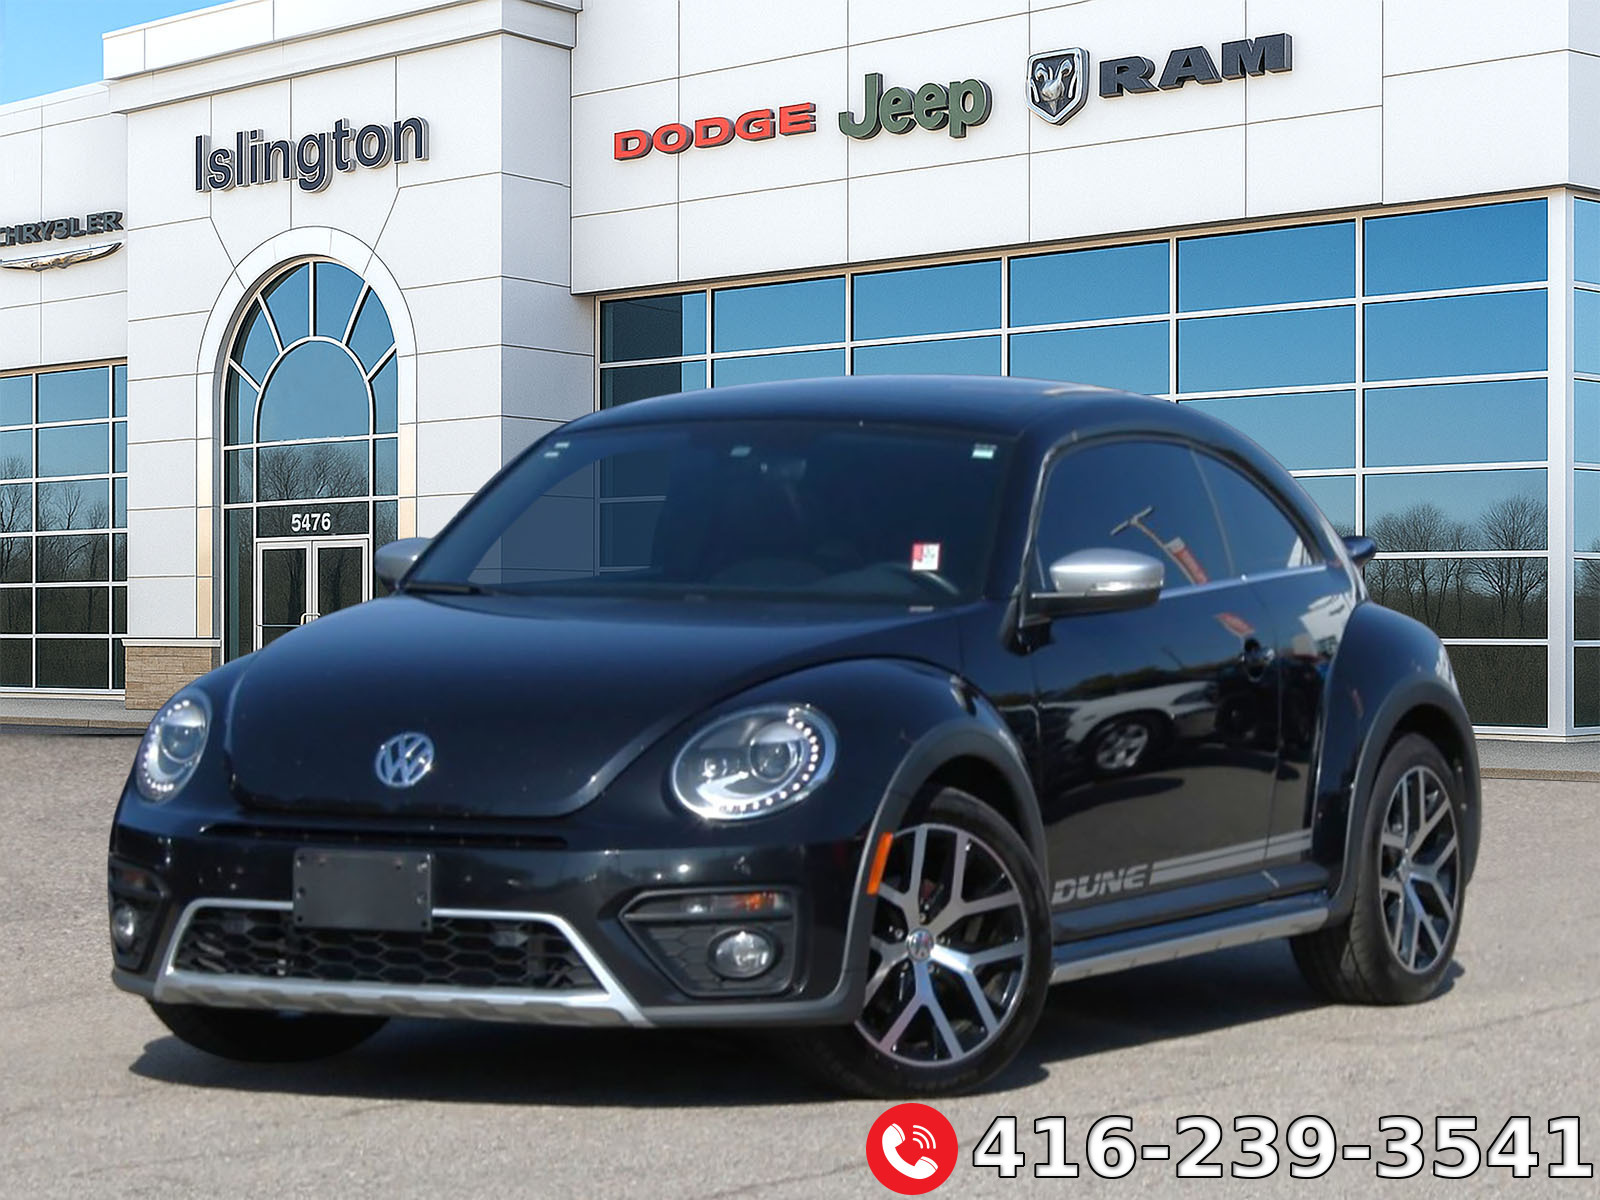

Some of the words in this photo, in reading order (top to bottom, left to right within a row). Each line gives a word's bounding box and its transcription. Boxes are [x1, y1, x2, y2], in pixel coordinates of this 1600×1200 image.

[614, 102, 817, 161] DODGE
[838, 72, 992, 140] Jeep
[1100, 33, 1293, 97] RAM
[195, 115, 428, 192] Islington
[291, 512, 331, 532] 5476
[1051, 863, 1149, 906] DUNE
